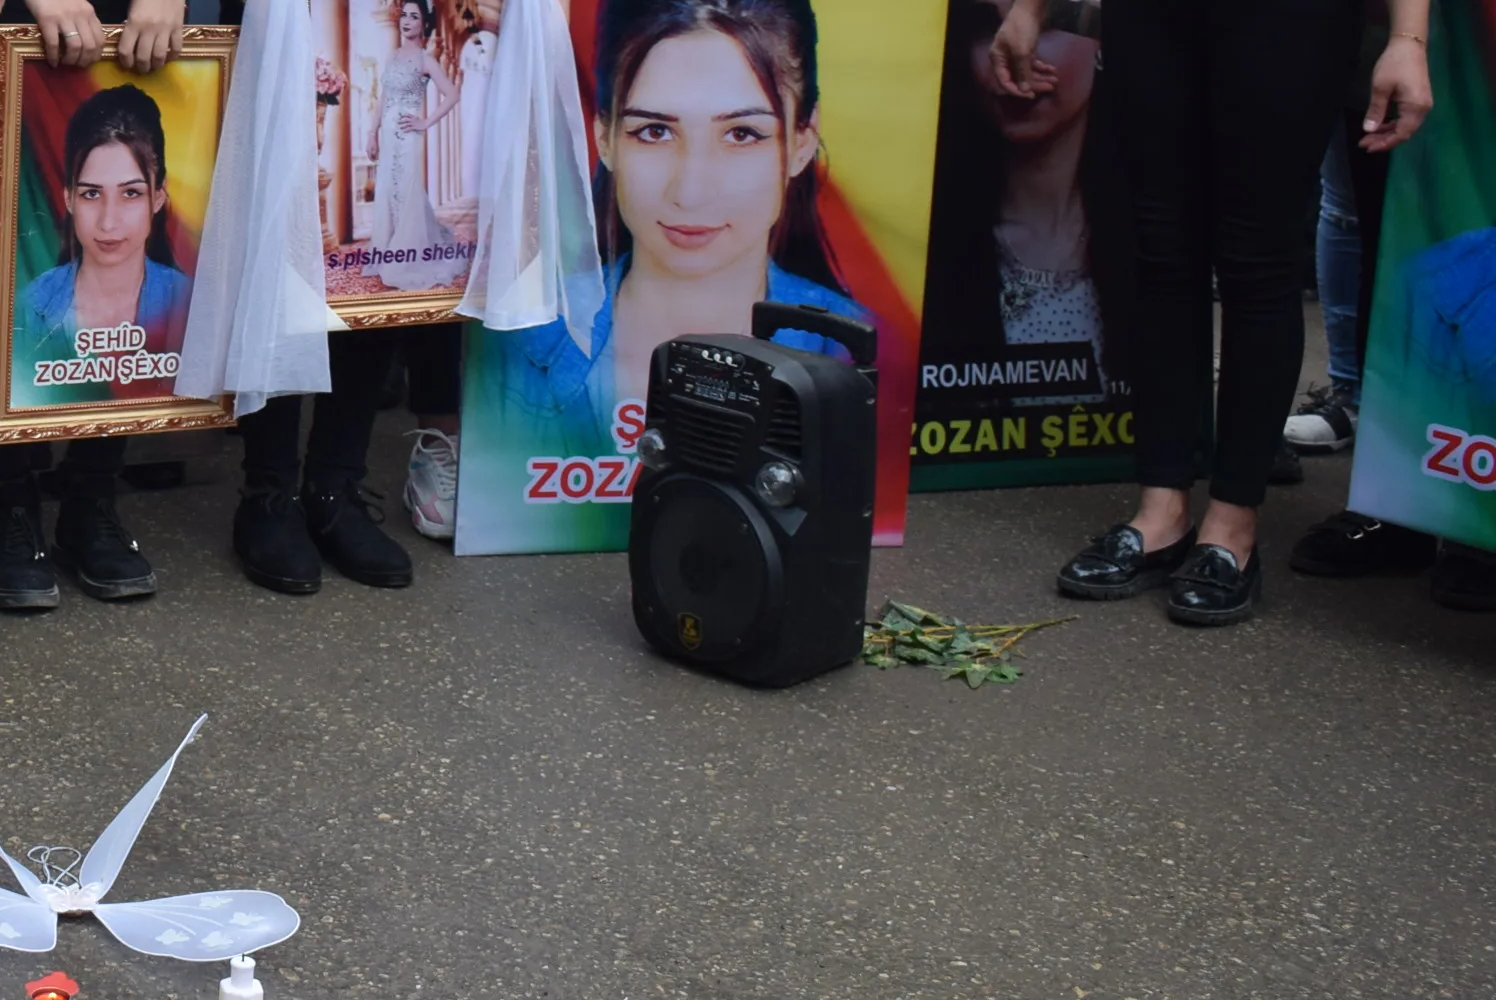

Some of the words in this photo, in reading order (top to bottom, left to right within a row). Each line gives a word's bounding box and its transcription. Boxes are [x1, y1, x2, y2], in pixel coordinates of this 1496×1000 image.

[76, 323, 145, 356] ŞEHÎD
[35, 358, 114, 385] ZOZAN
[119, 351, 181, 382] ŞÊXO
[922, 357, 1088, 389] ROJNAMEVAN
